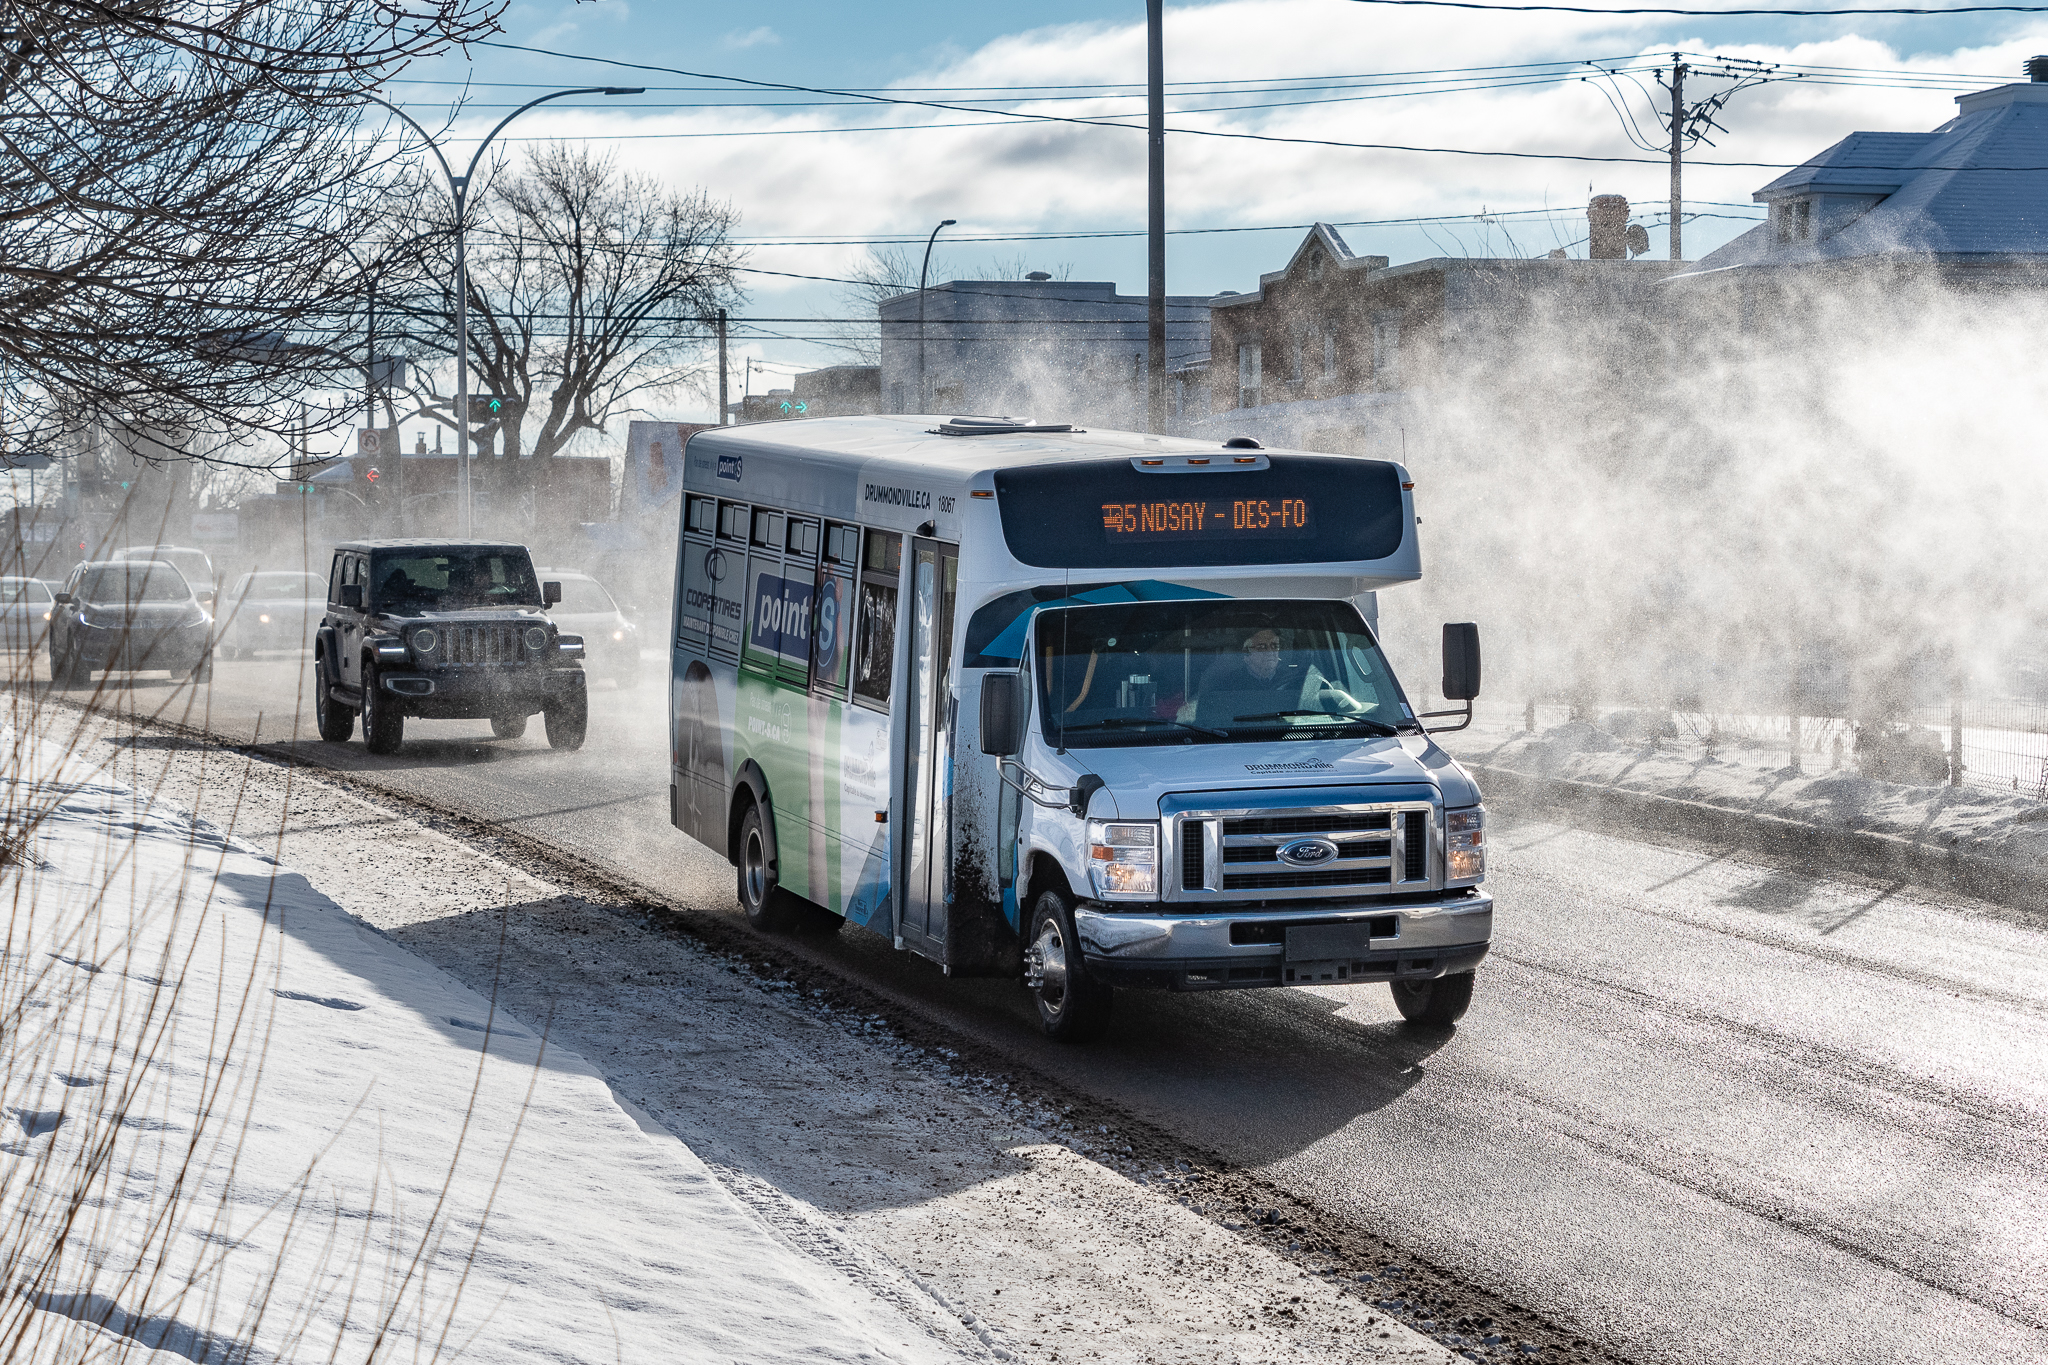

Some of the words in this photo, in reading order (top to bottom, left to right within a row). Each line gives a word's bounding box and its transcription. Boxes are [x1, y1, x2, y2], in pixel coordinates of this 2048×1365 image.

[719, 459, 735, 475] point
[864, 483, 931, 511] DRUMMONDVILLE.CA
[938, 495, 956, 514] 18067
[1141, 501, 1206, 532] NDSAY
[1233, 499, 1306, 529] DES-FO
[757, 588, 809, 640] point
[819, 596, 835, 651] S
[706, 623, 730, 641] DPONIBLE
[1296, 846, 1323, 858] Ford
